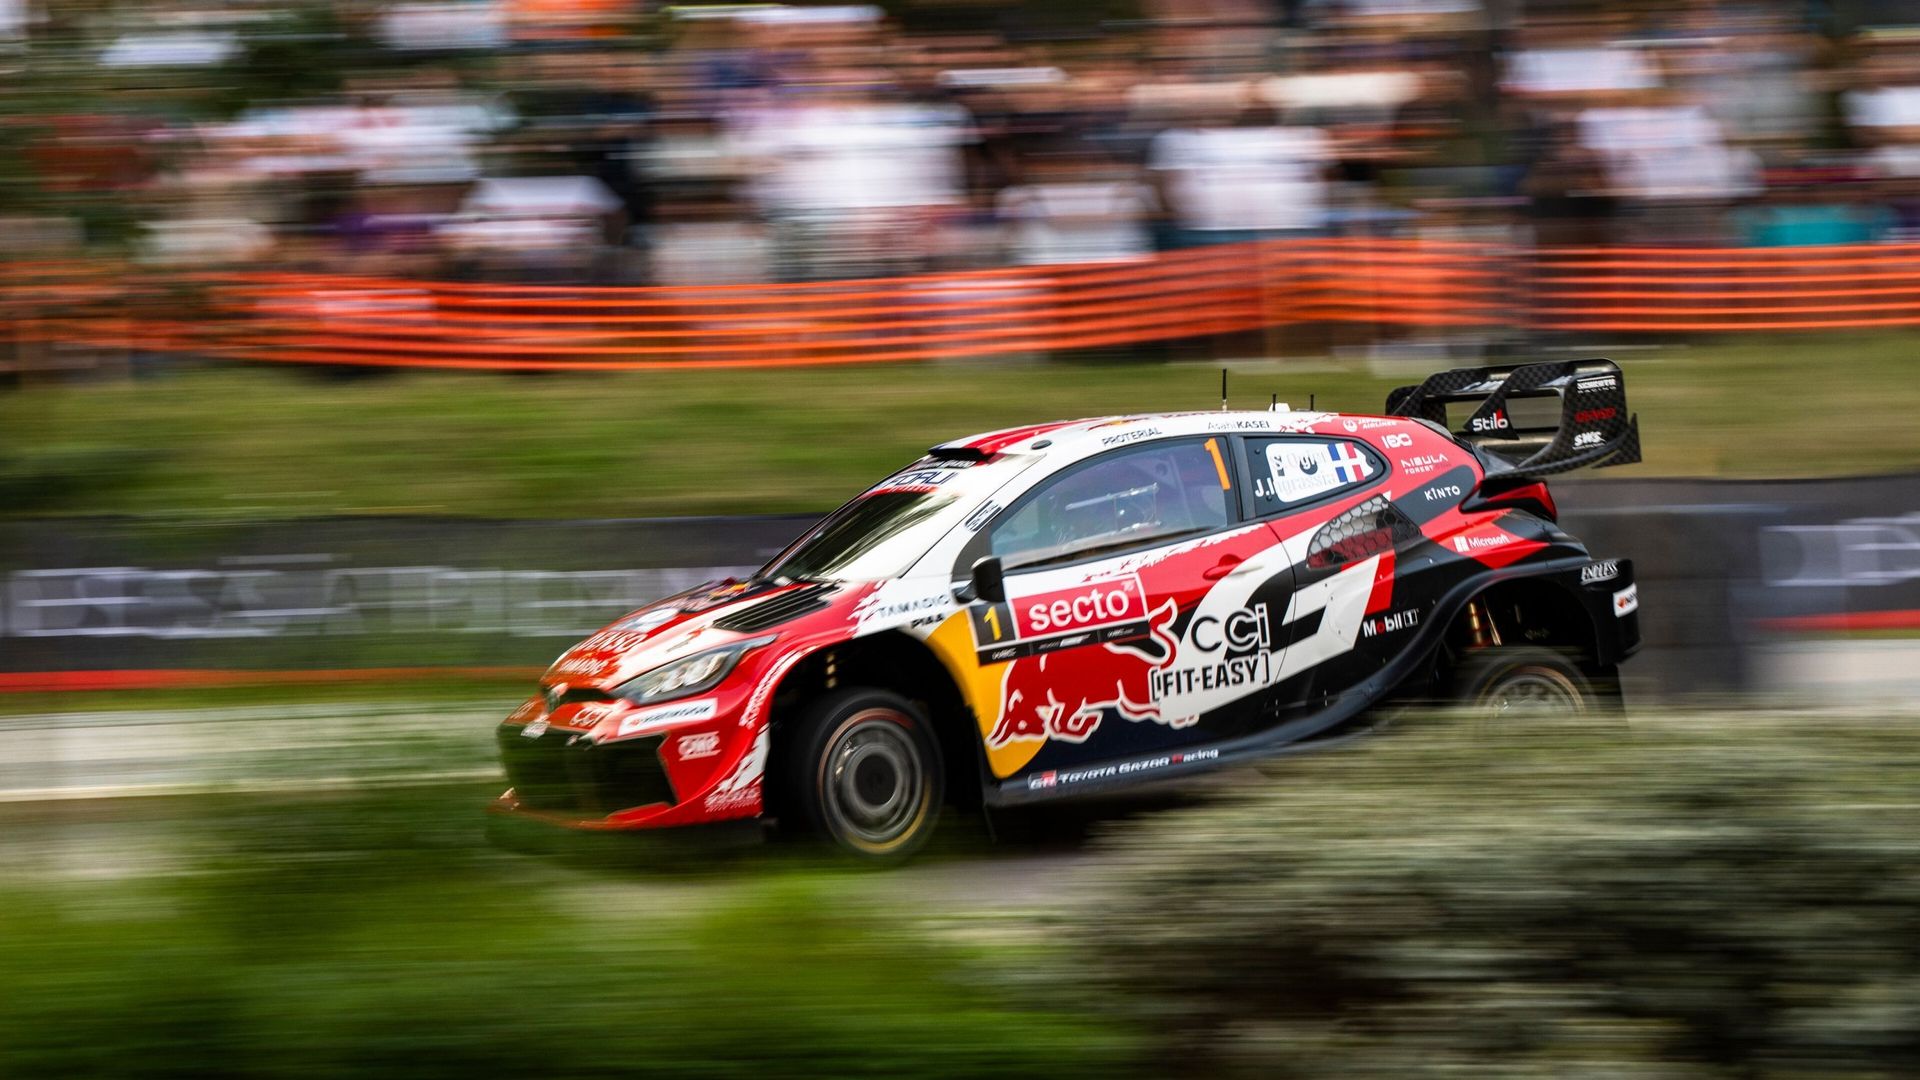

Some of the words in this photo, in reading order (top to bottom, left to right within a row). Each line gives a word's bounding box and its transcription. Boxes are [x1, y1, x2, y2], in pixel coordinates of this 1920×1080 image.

[1472, 412, 1509, 432] Stilo
[1101, 426, 1163, 447] PROTERIAL
[1203, 437, 1231, 491] 1
[1423, 485, 1461, 501] KINTO
[1467, 533, 1512, 549] Microsoft
[1028, 588, 1130, 632] secto
[983, 606, 1002, 641] 1
